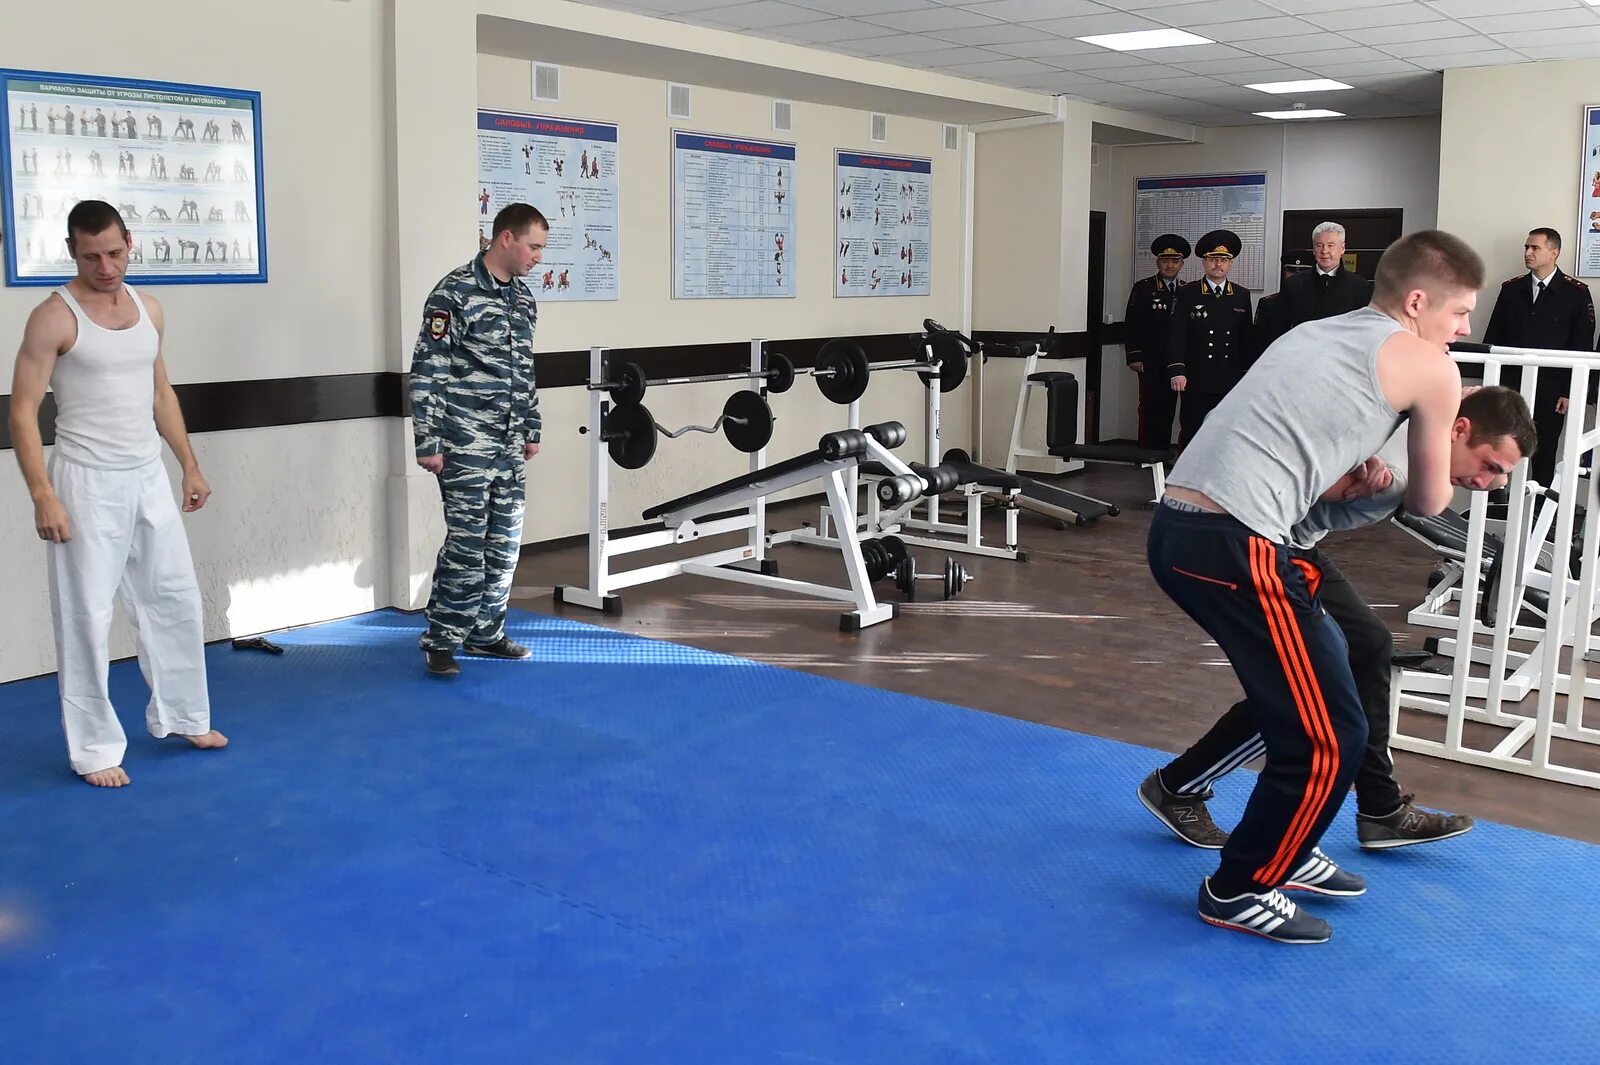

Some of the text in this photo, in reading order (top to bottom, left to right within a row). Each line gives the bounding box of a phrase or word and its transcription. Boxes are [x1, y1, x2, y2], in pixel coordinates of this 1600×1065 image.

[39, 84, 76, 93] ВАРИАНТЫ
[77, 87, 106, 96] ЗАЩИТЫ
[116, 90, 143, 99] УГРОЗЫ
[143, 92, 184, 102] ПИСТОЛЕТОМ
[190, 96, 227, 105] АВТОМАТОМ
[495, 118, 586, 136] СИЛОВЫЕ УПРАЖНЕНИЯ
